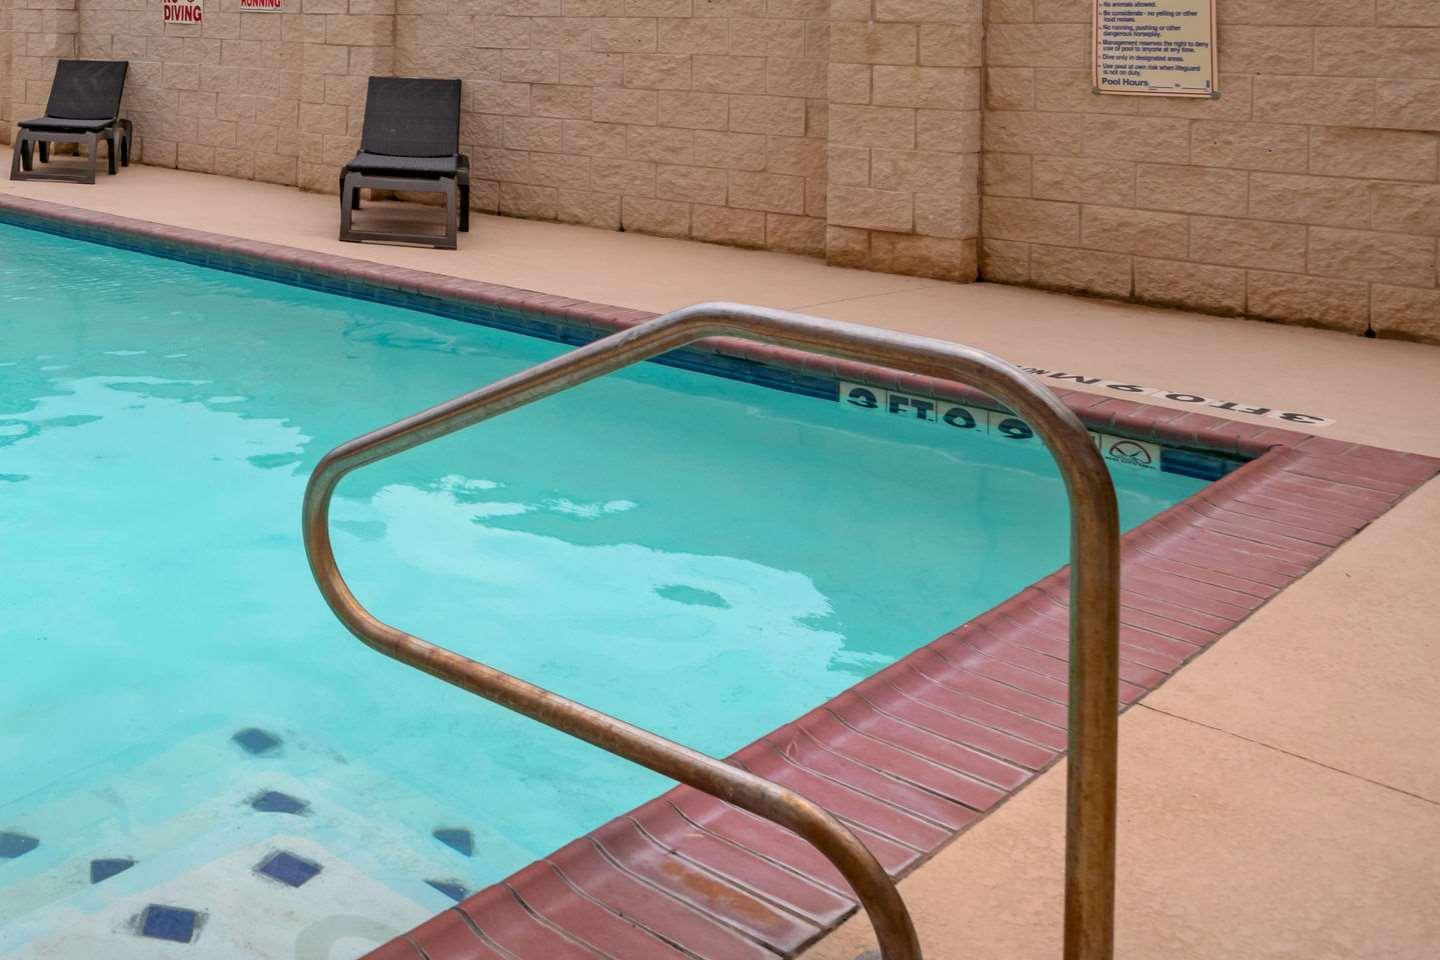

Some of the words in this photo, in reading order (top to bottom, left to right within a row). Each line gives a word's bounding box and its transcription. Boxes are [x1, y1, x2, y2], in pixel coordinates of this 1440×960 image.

[164, 5, 202, 21] DIVING
[1102, 77, 1120, 85] Pool
[1279, 412, 1326, 424] 3
